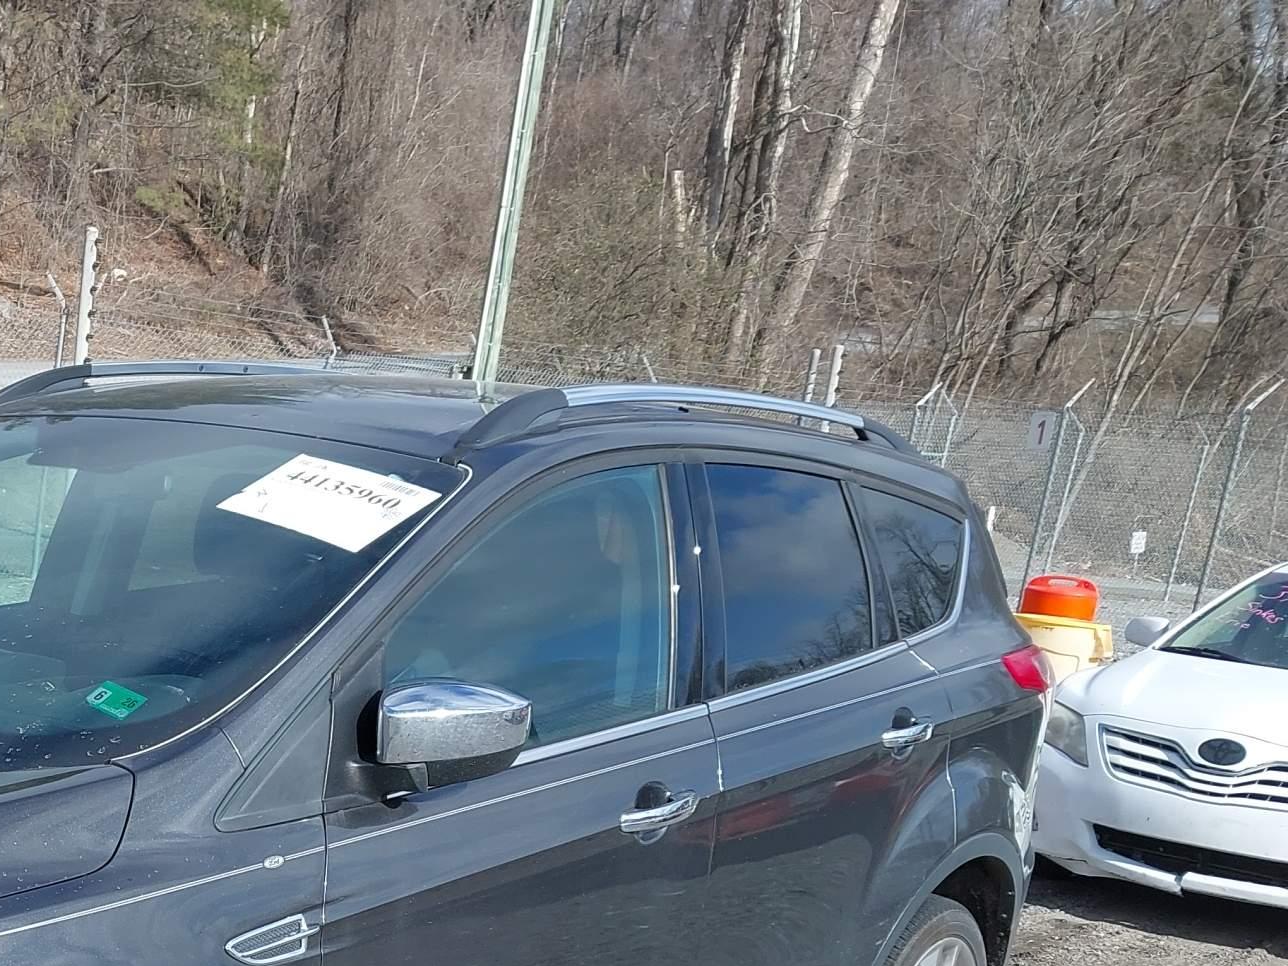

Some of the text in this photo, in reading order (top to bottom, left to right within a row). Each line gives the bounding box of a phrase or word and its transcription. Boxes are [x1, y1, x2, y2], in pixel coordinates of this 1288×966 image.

[1038, 420, 1046, 445] 1
[286, 470, 402, 511] 44135960
[93, 690, 108, 701] 6
[121, 697, 139, 709] 26
